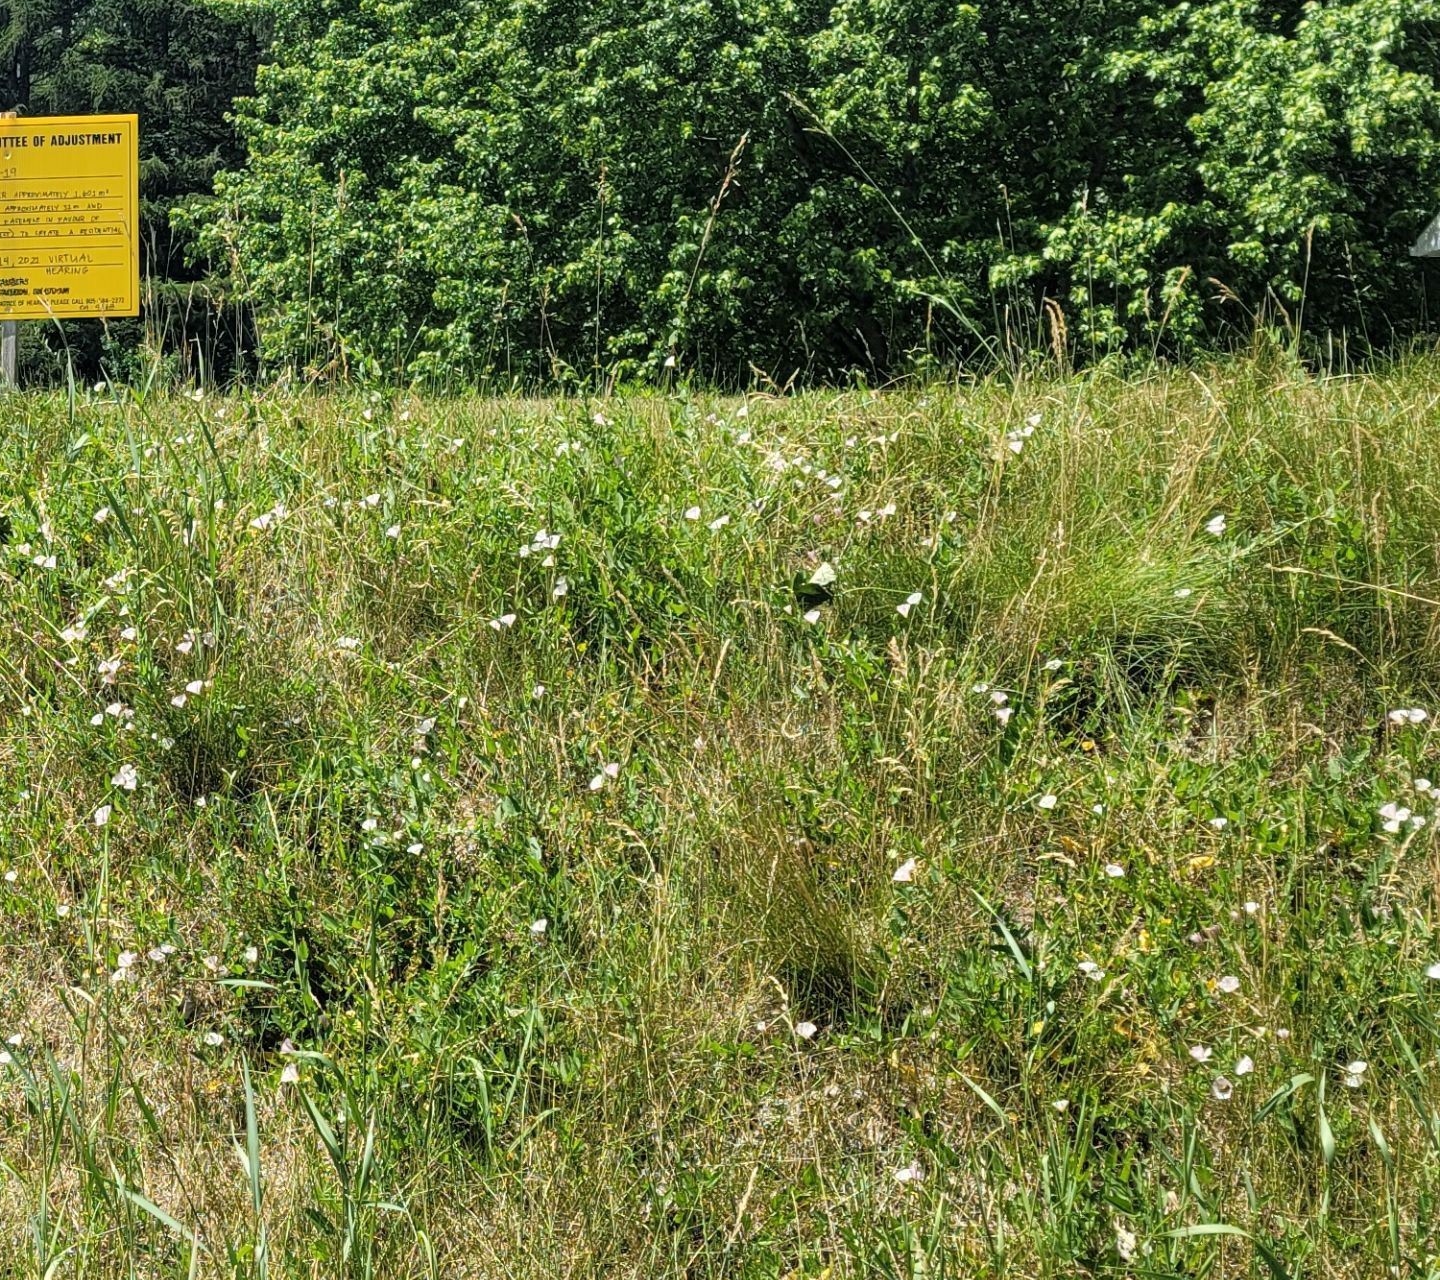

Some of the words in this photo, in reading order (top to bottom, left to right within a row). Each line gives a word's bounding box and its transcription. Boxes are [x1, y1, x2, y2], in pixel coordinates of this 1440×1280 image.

[33, 135, 45, 147] OF
[50, 133, 122, 147] ADJUSTMENT
[48, 253, 94, 264] VIRTUAL
[46, 266, 89, 276] HEARING
